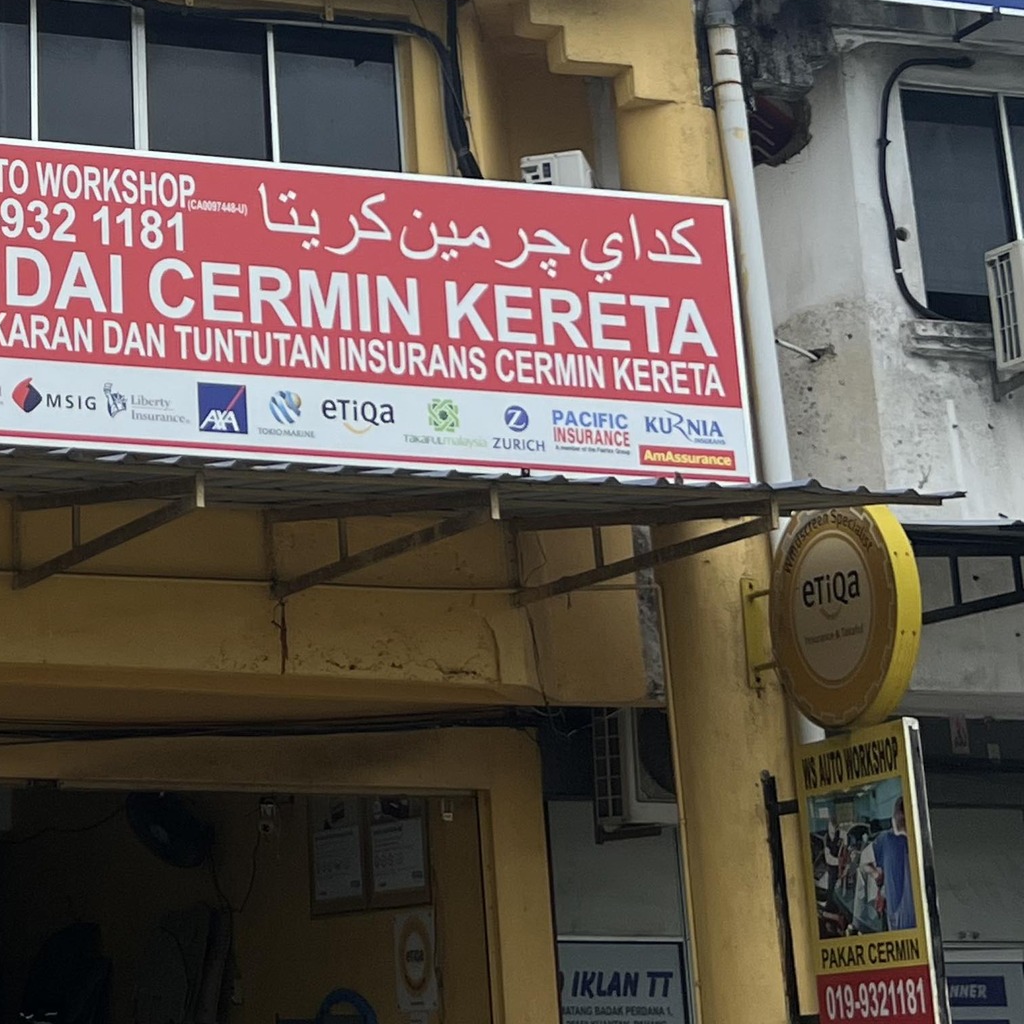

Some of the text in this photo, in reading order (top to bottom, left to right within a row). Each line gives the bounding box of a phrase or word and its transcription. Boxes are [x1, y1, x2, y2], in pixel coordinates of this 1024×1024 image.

[36, 161, 196, 208] WORKSHOP
[92, 205, 186, 252] 1181
[148, 257, 421, 337] CERMIN
[443, 280, 719, 358] KERETA
[103, 320, 166, 359] DAN
[174, 324, 330, 370] TUNTUTAN
[339, 336, 487, 381] INSURANS
[495, 347, 605, 390] CERMIN
[614, 356, 726, 398] KERETA
[46, 393, 97, 411] MSIG
[131, 394, 171, 410] Liberty
[131, 410, 186, 424] Insurance
[199, 409, 241, 432] AXA
[552, 409, 629, 430] PACIFIC
[492, 437, 546, 453] ZURICH
[553, 426, 631, 448] INSURANCE
[643, 449, 733, 466] AmAssurance
[802, 736, 898, 790] WS AUTO WORKSHOP
[821, 938, 920, 969] PAKAR CERMIN
[571, 970, 640, 999] IKLAN
[563, 1005, 592, 1015] ATANG
[825, 977, 926, 1021] 019-9321181
